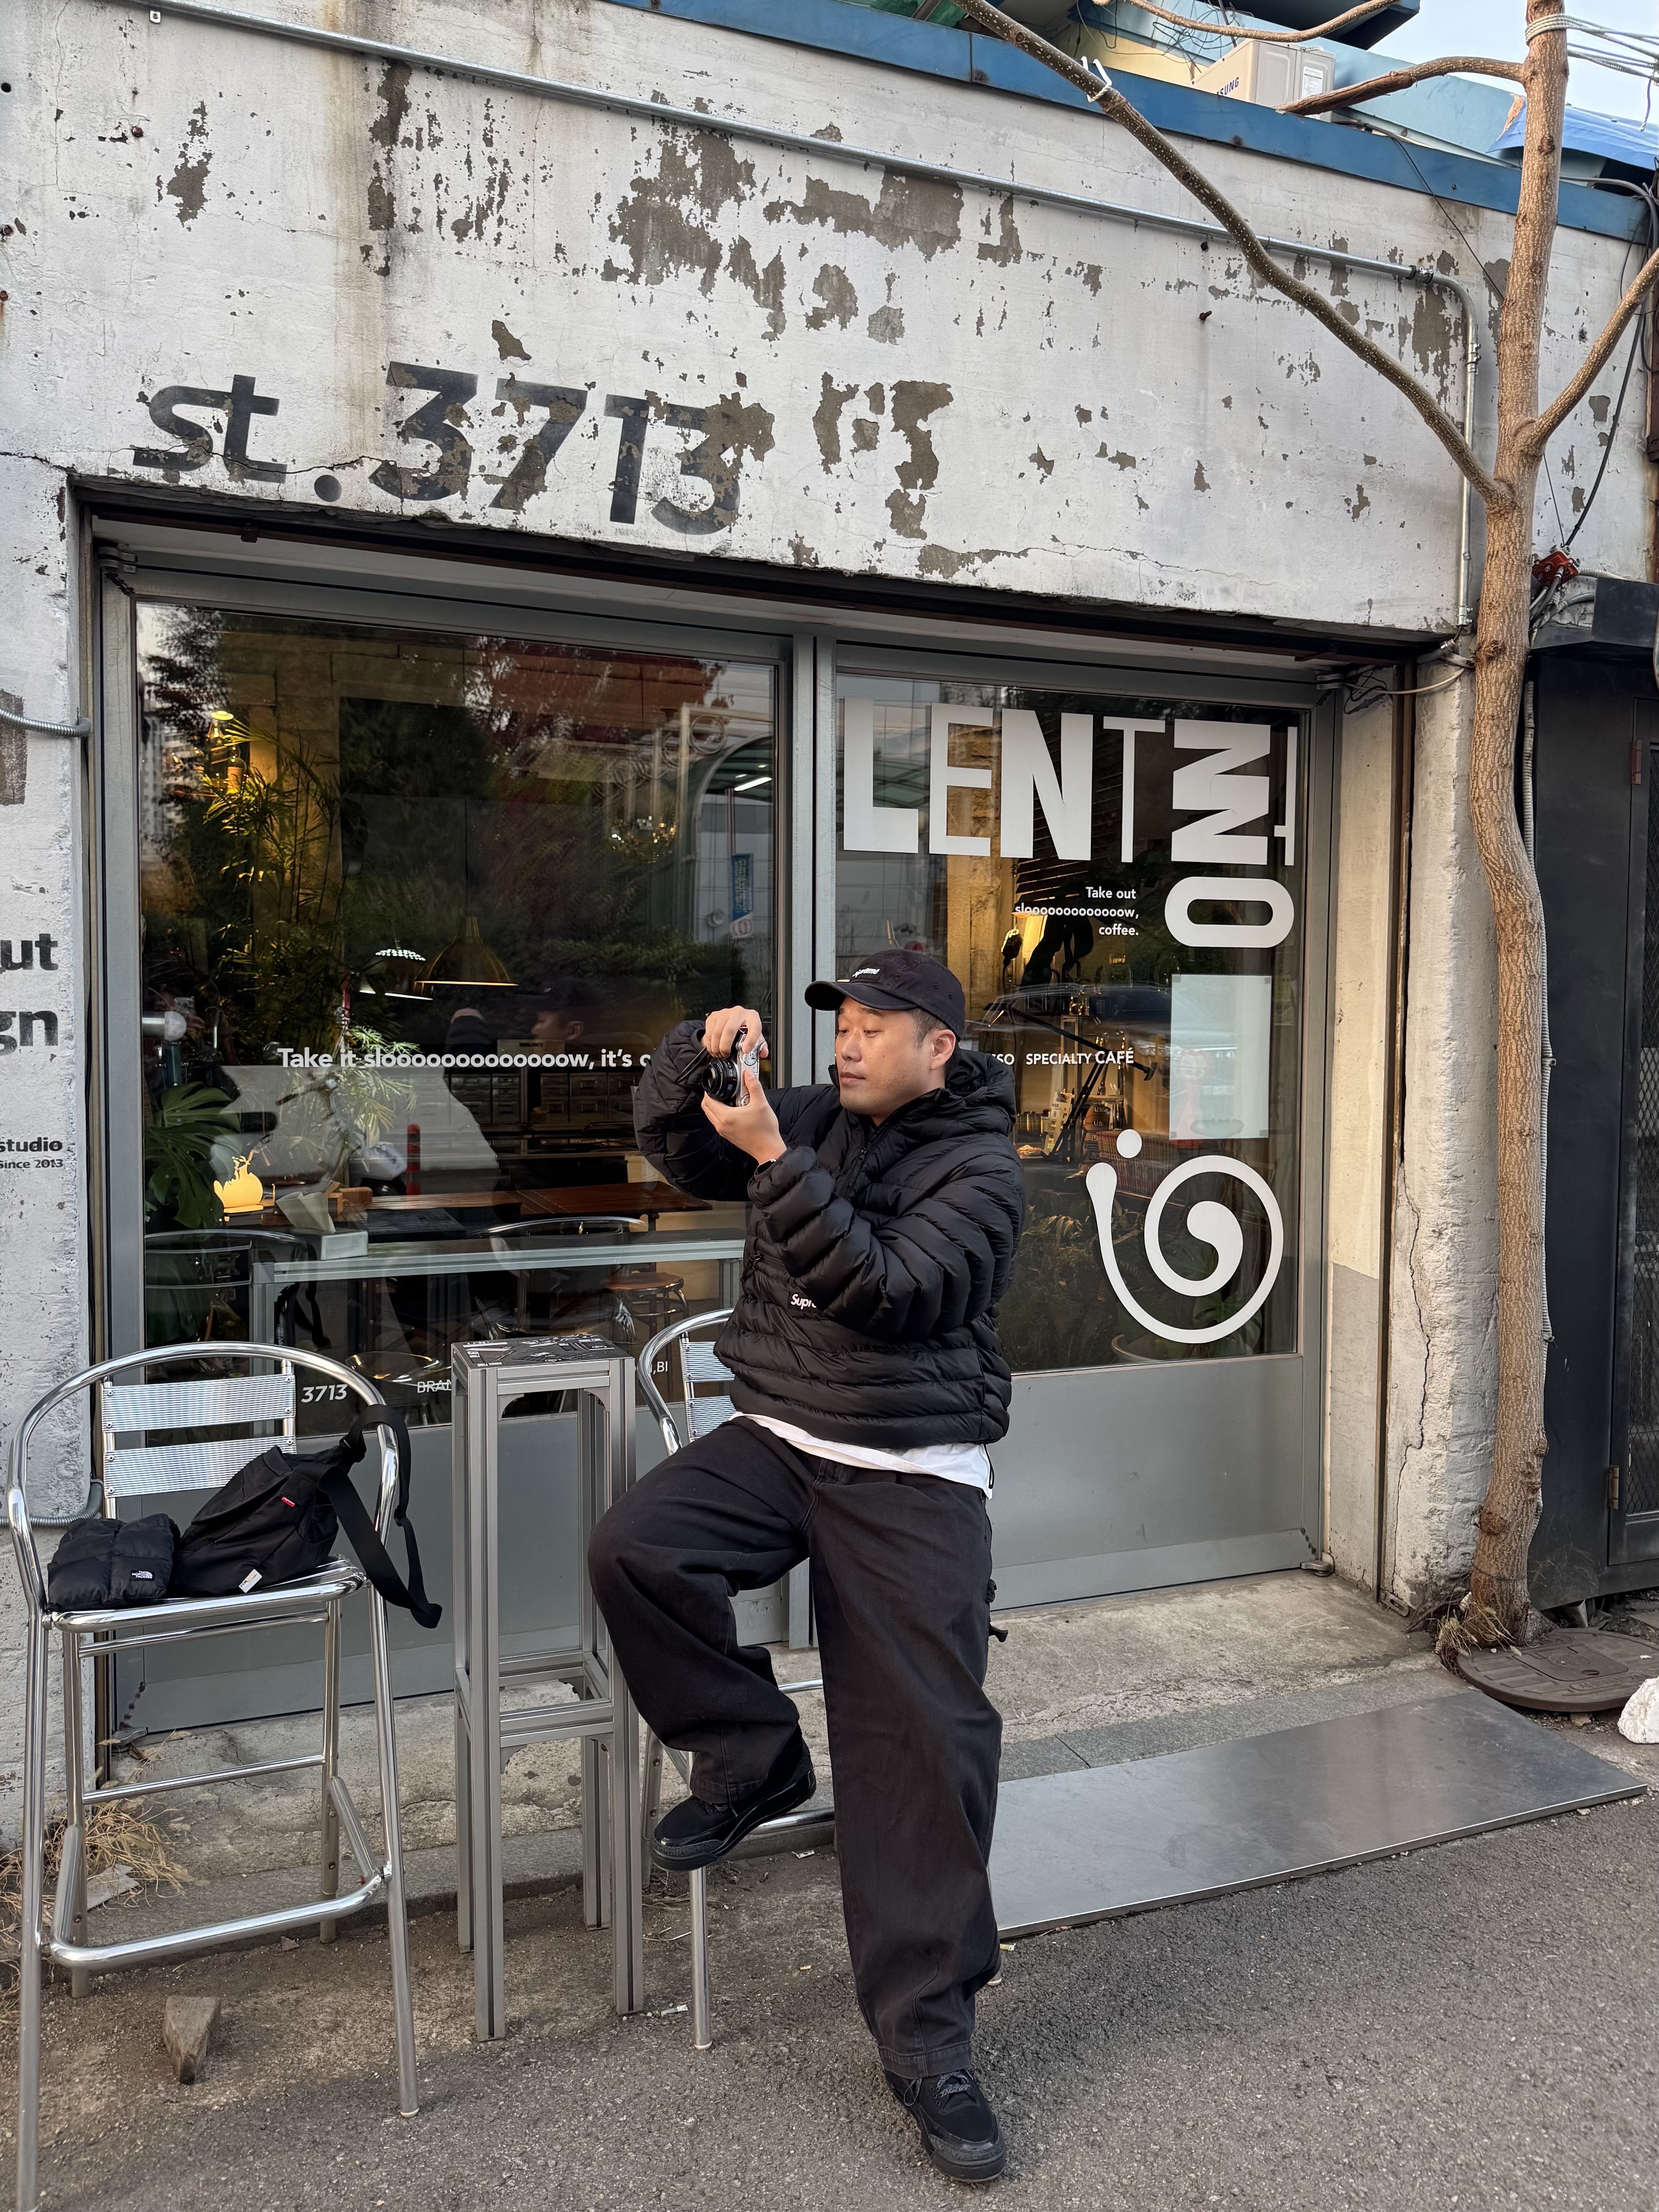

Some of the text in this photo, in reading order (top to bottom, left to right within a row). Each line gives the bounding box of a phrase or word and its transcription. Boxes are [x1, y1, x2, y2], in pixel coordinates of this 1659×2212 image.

[1216, 77, 1239, 95] SUNG
[844, 696, 1166, 863] LENT
[1085, 886, 1136, 899] Take out
[1098, 923, 1139, 936] coffee.
[277, 1047, 333, 1067] Take
[340, 1048, 357, 1067] it
[1025, 1053, 1092, 1065] SPECIALTY
[1094, 1047, 1134, 1065] CAFÉ
[34, 1159, 63, 1168] 2013
[301, 1384, 348, 1403] 3713
